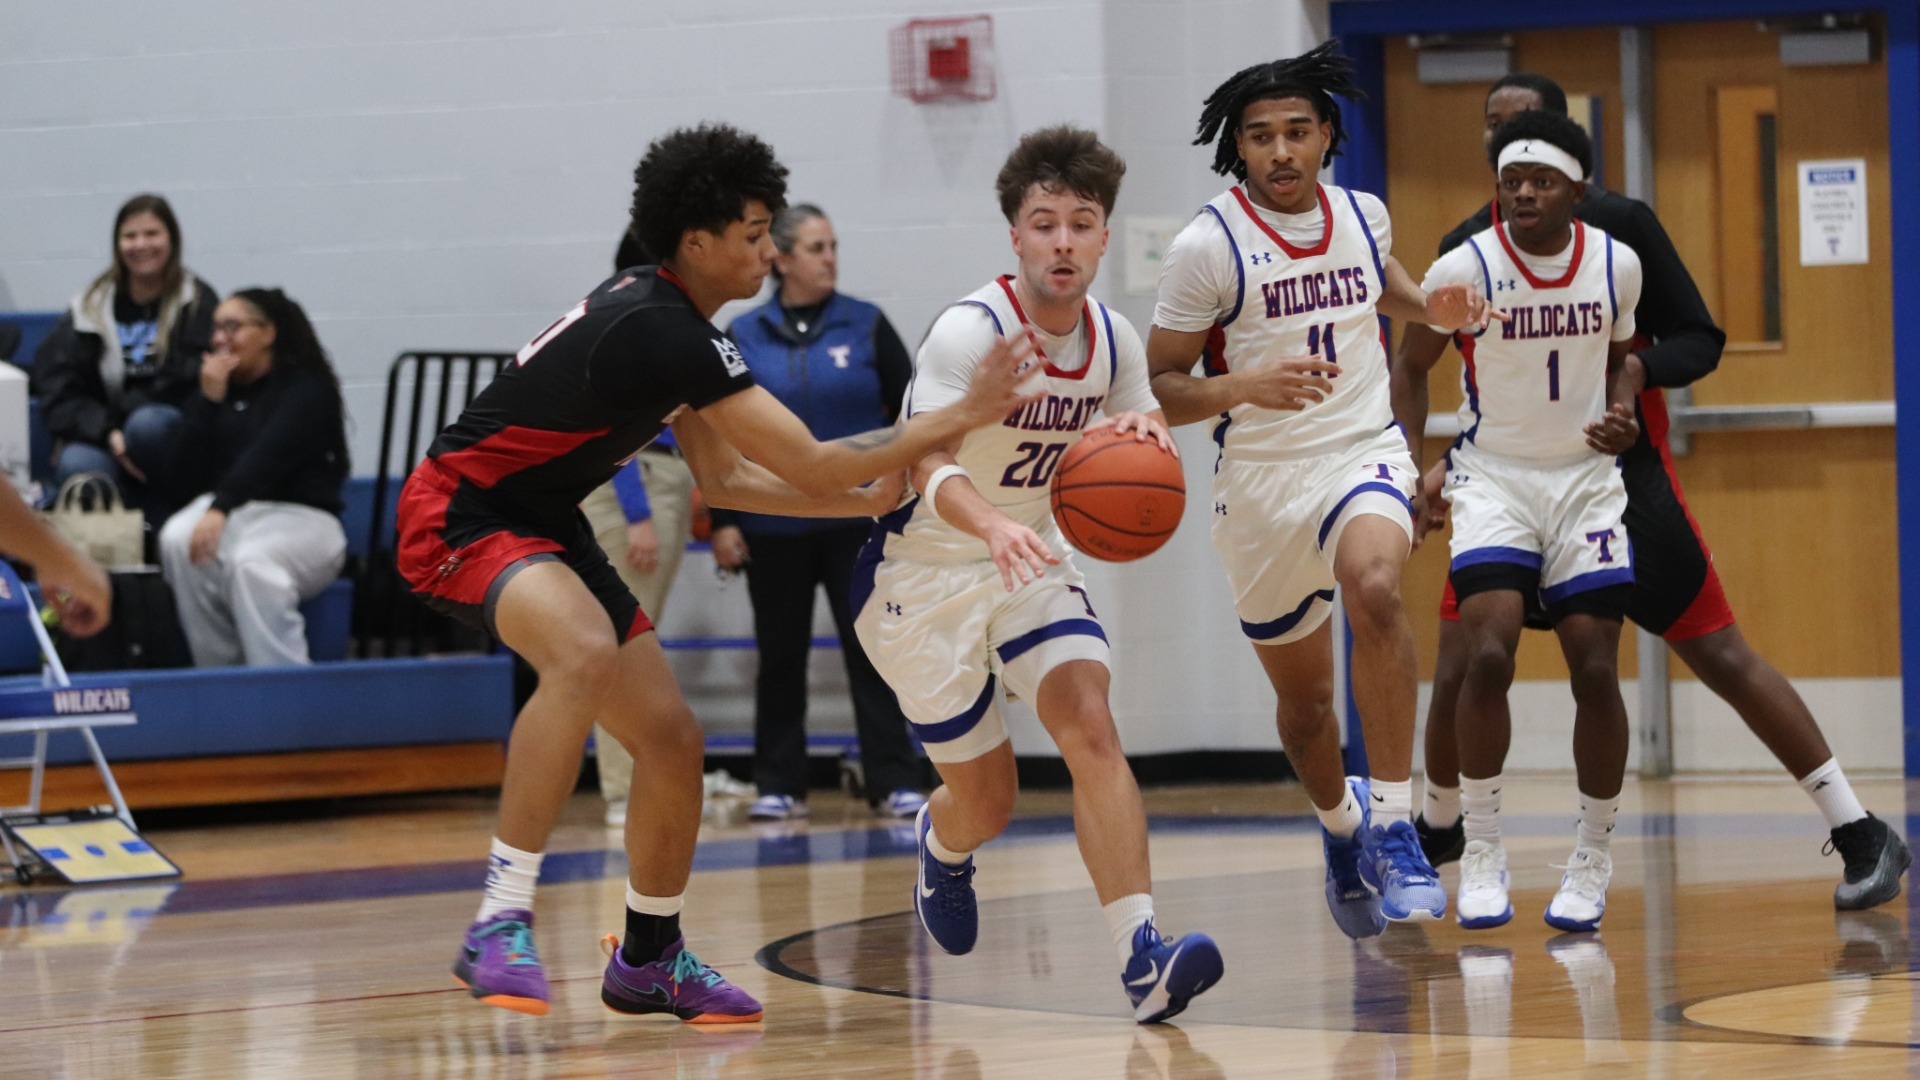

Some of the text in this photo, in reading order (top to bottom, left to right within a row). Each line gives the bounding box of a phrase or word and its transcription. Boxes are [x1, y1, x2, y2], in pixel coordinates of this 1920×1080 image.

[1262, 266, 1367, 318] WILDCATS
[1500, 302, 1602, 340] WILDCATS
[1307, 322, 1338, 379] 11
[1546, 349, 1560, 402] 1
[999, 442, 1068, 488] 20
[1585, 528, 1617, 564] T
[53, 688, 131, 713] WILDCATS
